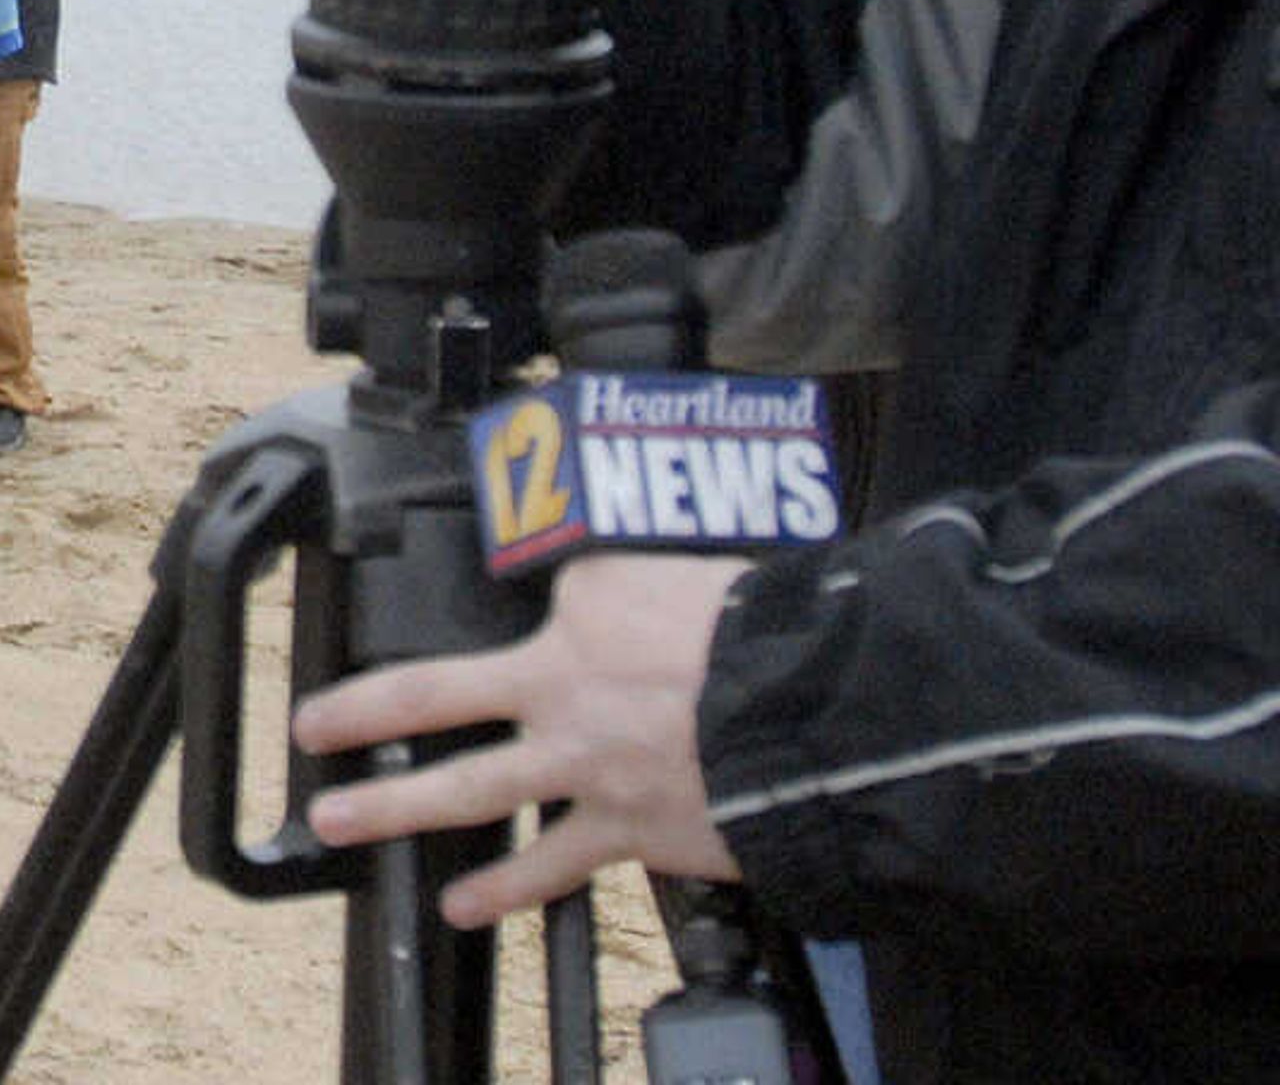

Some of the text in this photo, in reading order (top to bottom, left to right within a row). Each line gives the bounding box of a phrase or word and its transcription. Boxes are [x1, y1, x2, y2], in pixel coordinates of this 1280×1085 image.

[580, 375, 822, 428] Heartland
[485, 399, 571, 546] 12
[579, 434, 841, 541] NEWS
